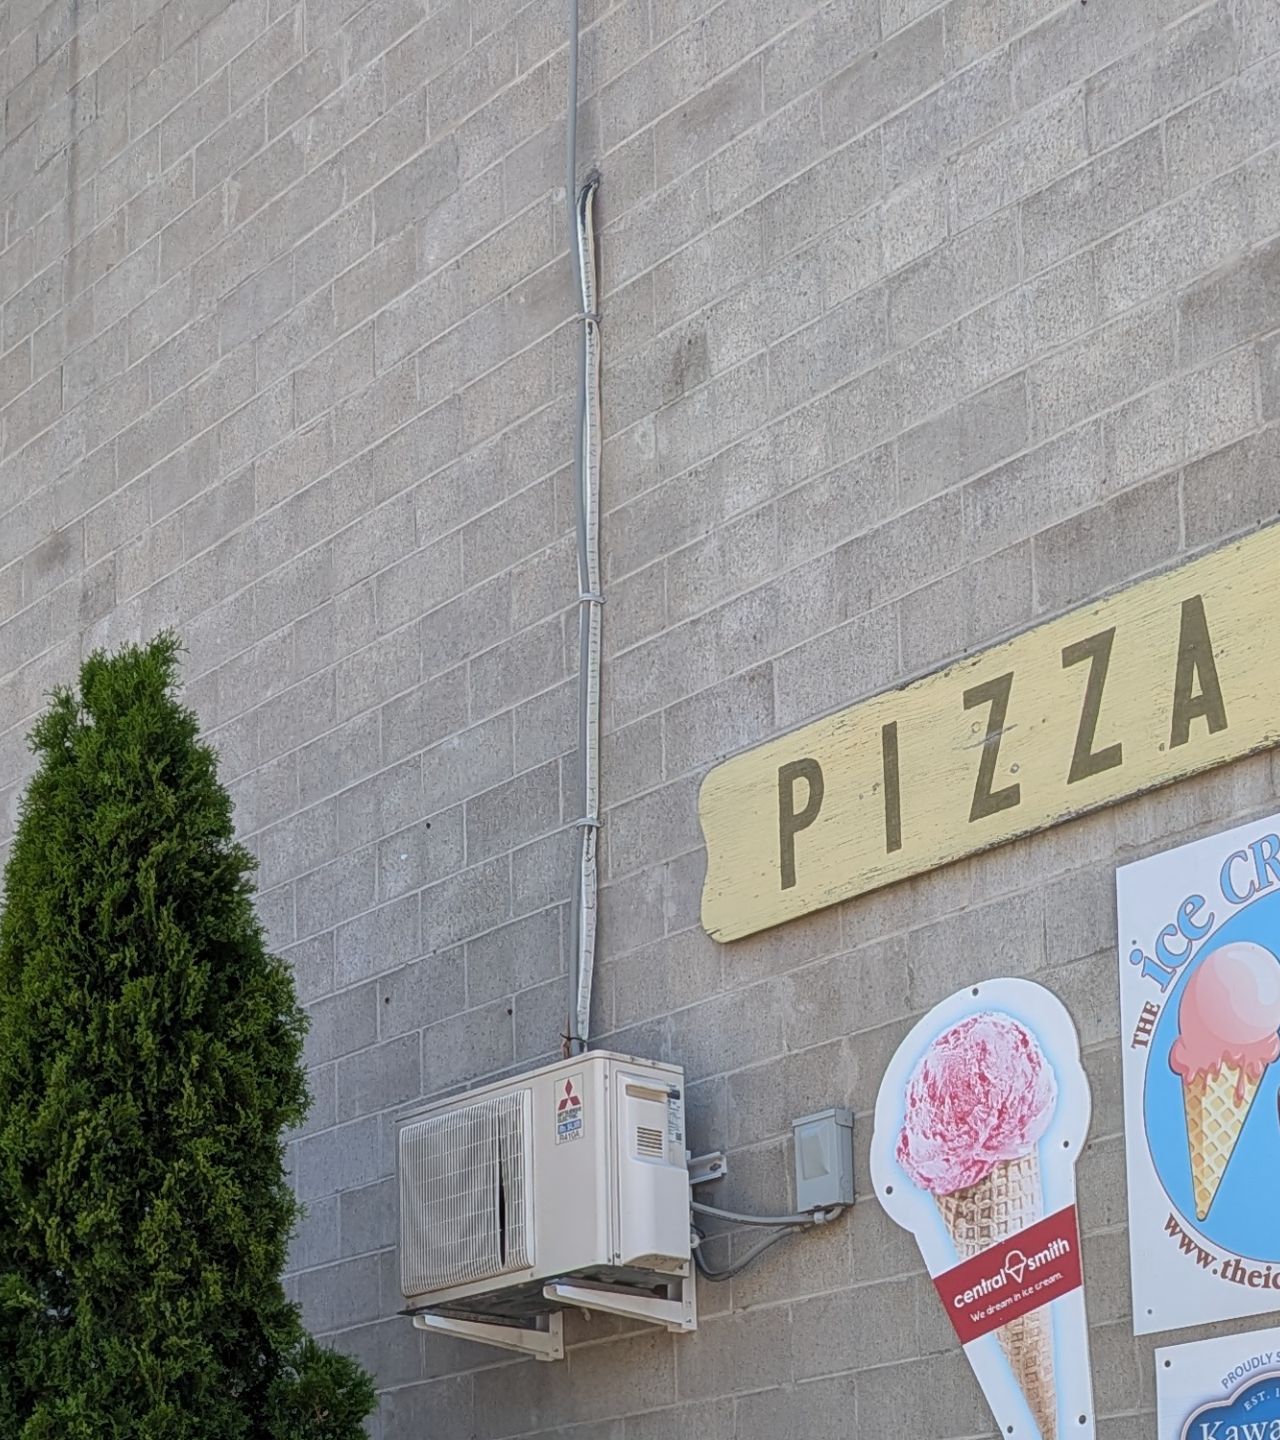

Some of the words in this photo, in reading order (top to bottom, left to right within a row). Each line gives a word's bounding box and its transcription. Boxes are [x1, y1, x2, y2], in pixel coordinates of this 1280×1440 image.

[1129, 893, 1216, 993] ice
[1130, 1000, 1161, 1050] THE
[953, 1269, 1007, 1309] central
[1027, 1237, 1070, 1271] smith
[970, 1308, 986, 1322] We
[986, 1296, 1013, 1315] dream
[1013, 1291, 1022, 1302] in
[1022, 1286, 1034, 1298] ice
[1221, 1351, 1274, 1389] PROUDLY
[1243, 1391, 1270, 1411] EST.
